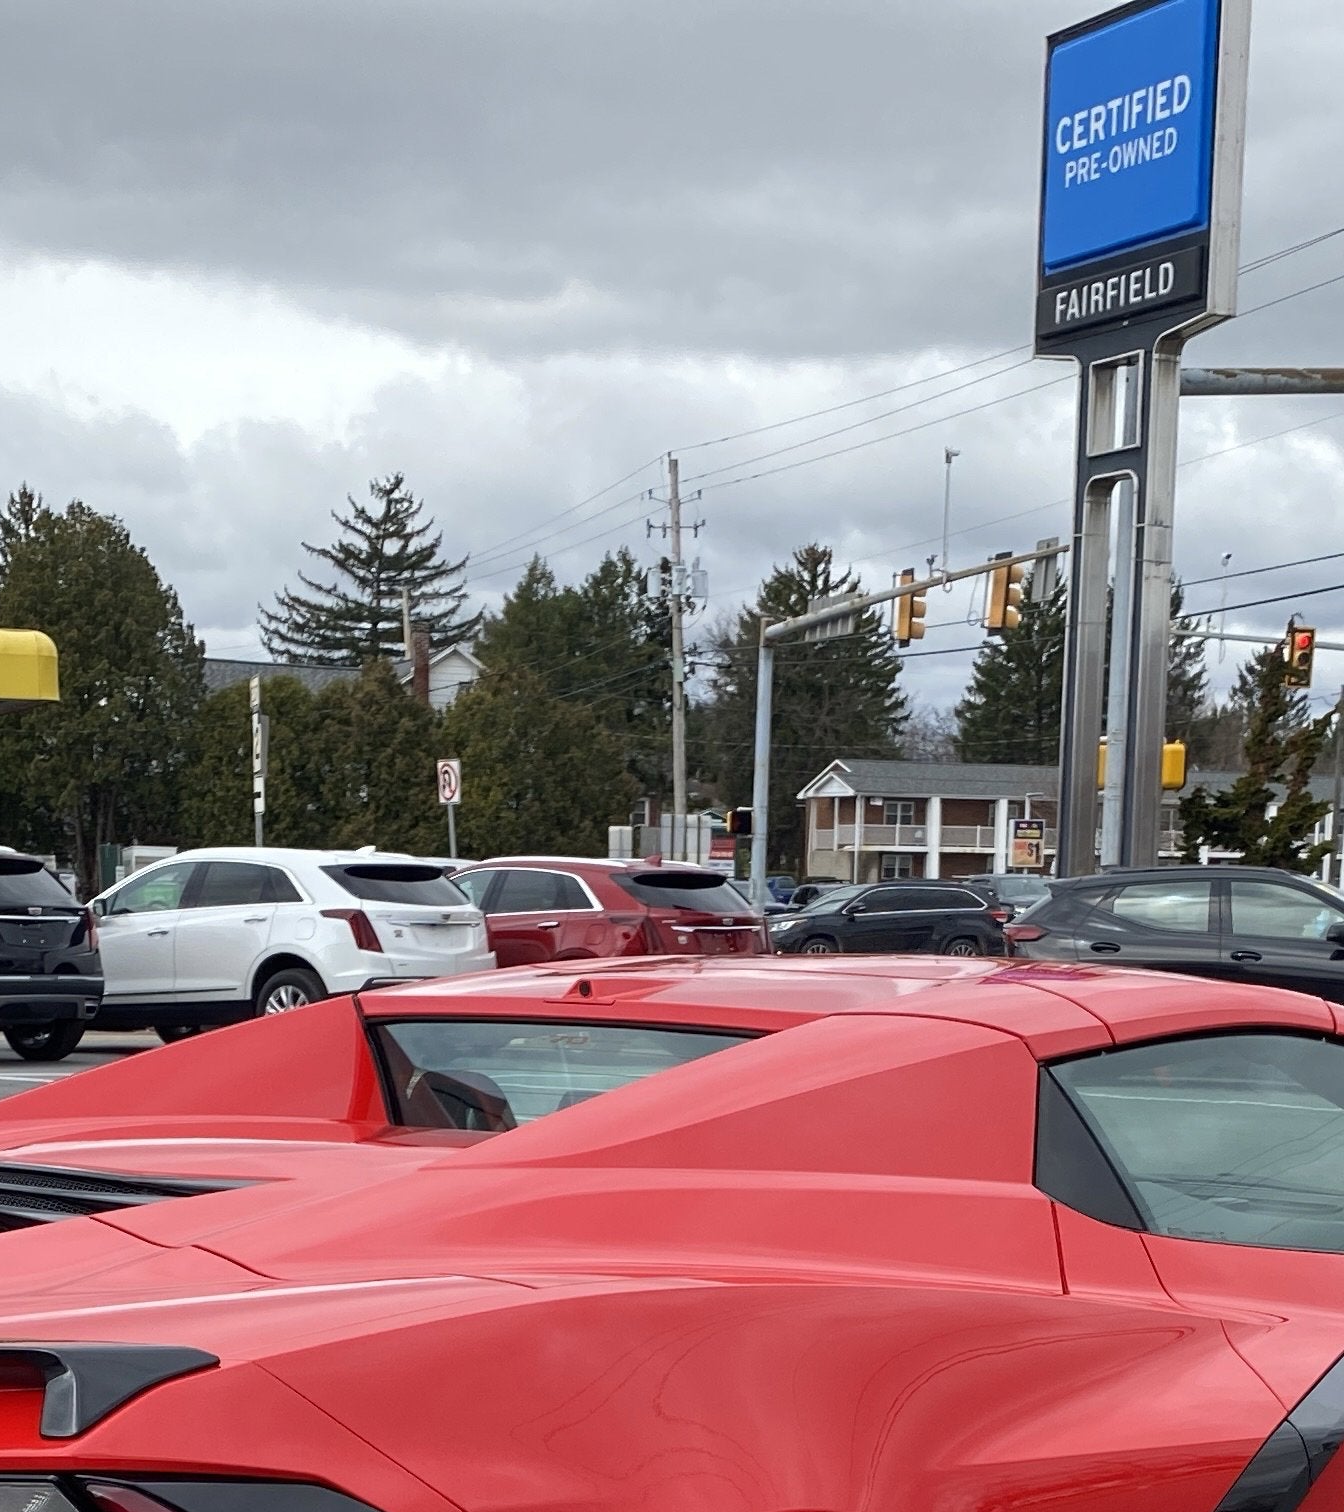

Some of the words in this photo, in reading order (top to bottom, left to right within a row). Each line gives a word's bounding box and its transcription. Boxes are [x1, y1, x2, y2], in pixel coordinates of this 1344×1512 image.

[1056, 74, 1192, 155] CERTIFIED
[1064, 127, 1178, 189] PRE-OWNED
[1054, 261, 1176, 325] FAIRFIELD
